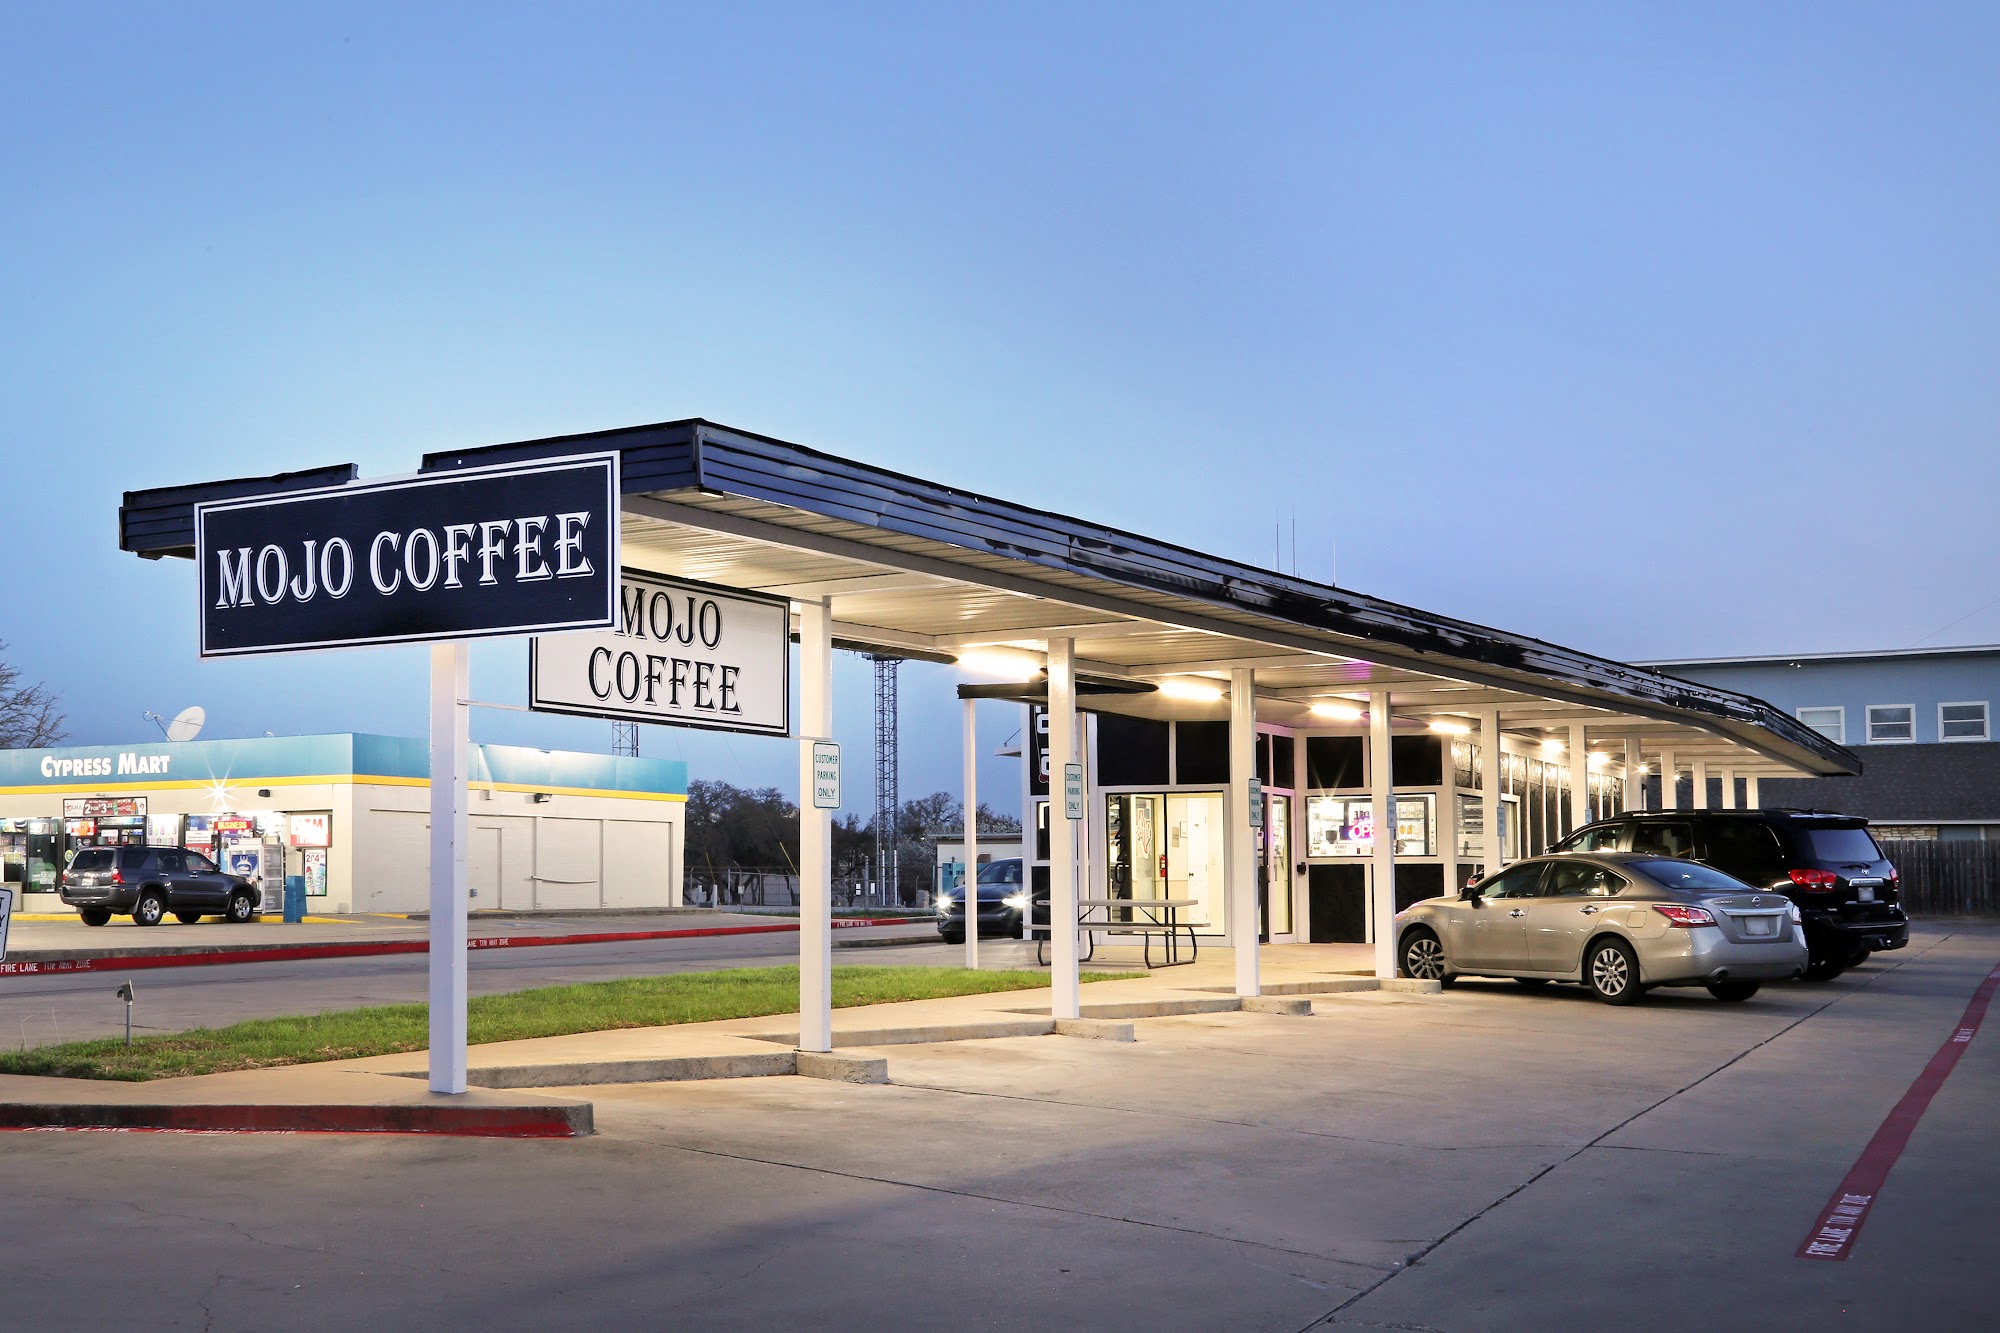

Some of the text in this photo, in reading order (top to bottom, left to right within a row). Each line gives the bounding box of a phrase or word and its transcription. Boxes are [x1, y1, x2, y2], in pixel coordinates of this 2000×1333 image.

[215, 511, 595, 609] MOJO COFFEE
[614, 584, 723, 650] MOJO
[588, 646, 743, 716] COFFEE
[815, 754, 838, 764] CUSTOMER
[817, 770, 836, 780] PARKING
[818, 788, 835, 797] ONLY
[1067, 801, 1080, 810] ONLY
[1352, 823, 1375, 839] OPE
[0, 963, 17, 973] FIRE
[20, 962, 38, 972] LANE
[1816, 1227, 1852, 1242] LANE
[1806, 1242, 1842, 1256] FIRE
